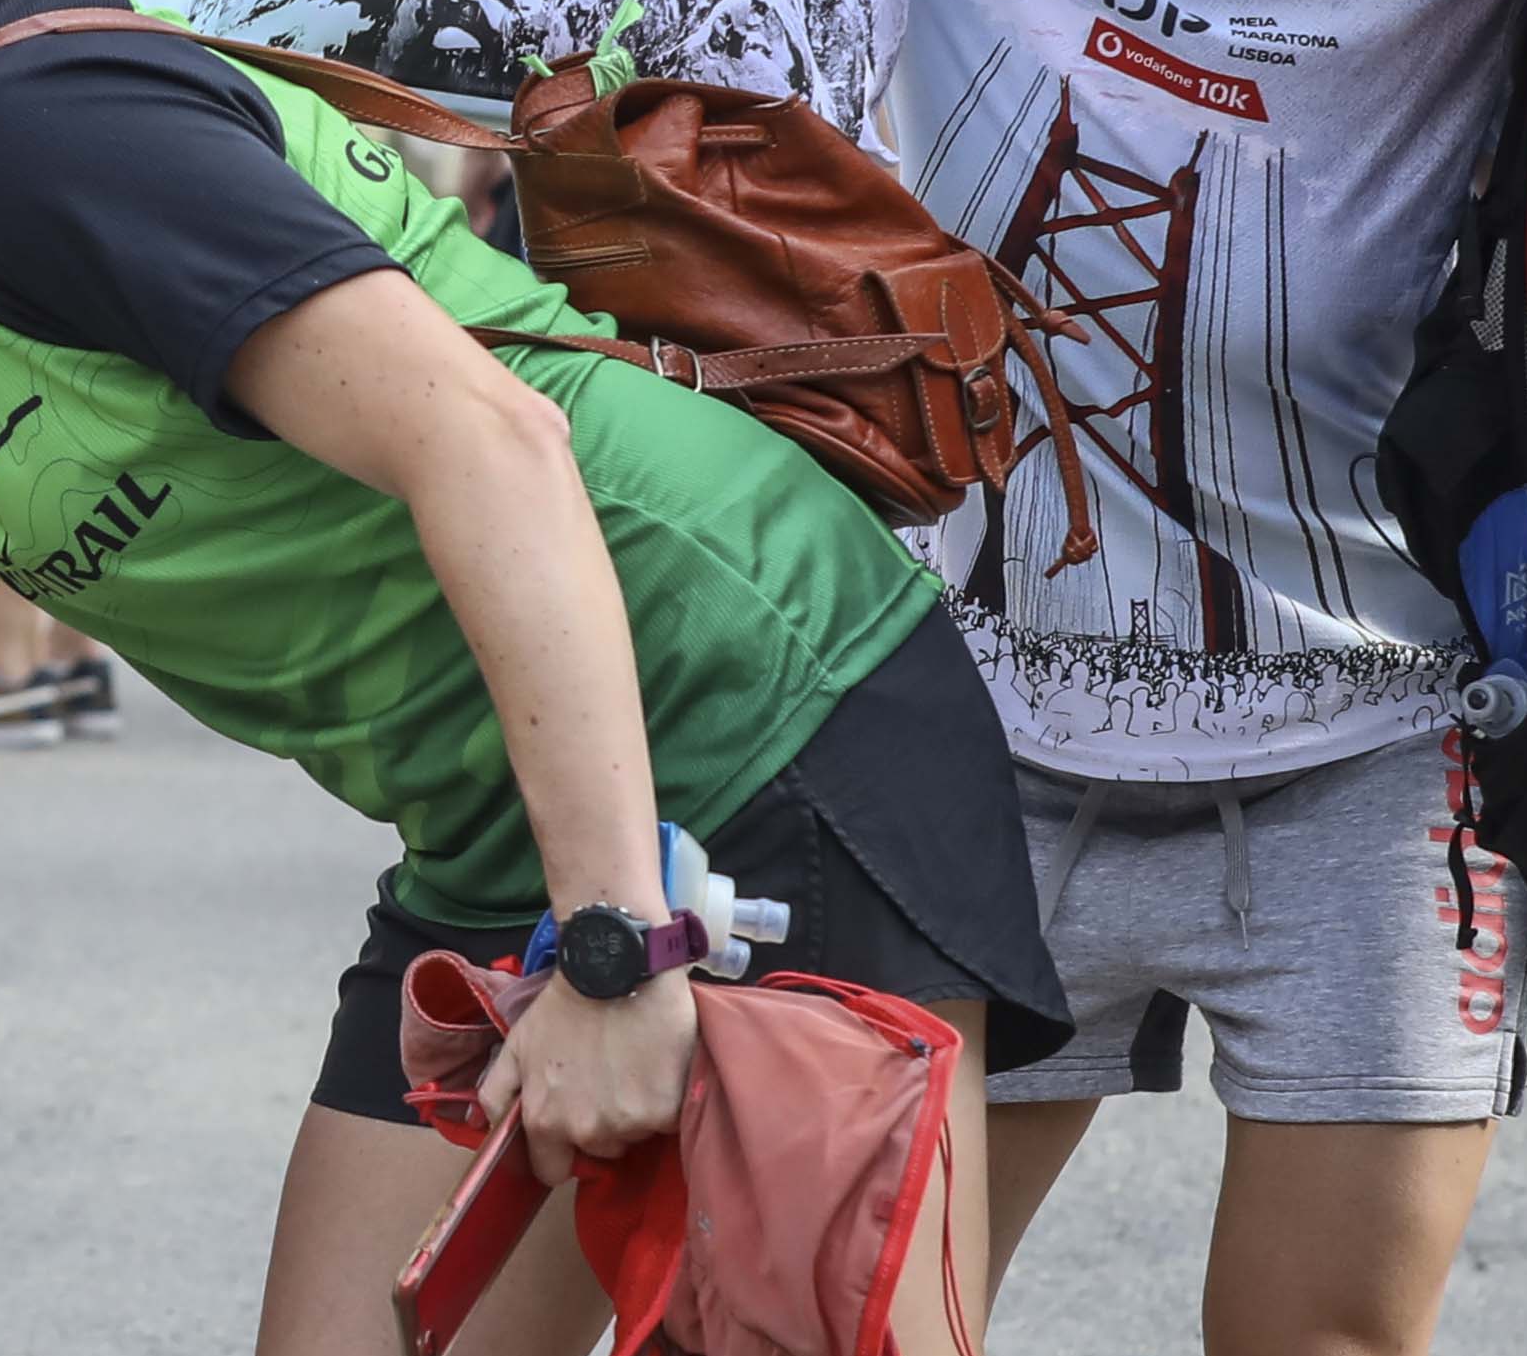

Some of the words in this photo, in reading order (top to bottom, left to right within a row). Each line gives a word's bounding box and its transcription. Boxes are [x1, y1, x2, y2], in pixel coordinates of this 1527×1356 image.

[1229, 17, 1278, 28] MEIA
[1231, 29, 1339, 49] MARATONA
[1228, 45, 1296, 66] LISBOA
[1125, 48, 1193, 88] vodafone
[1198, 77, 1249, 112] 10k
